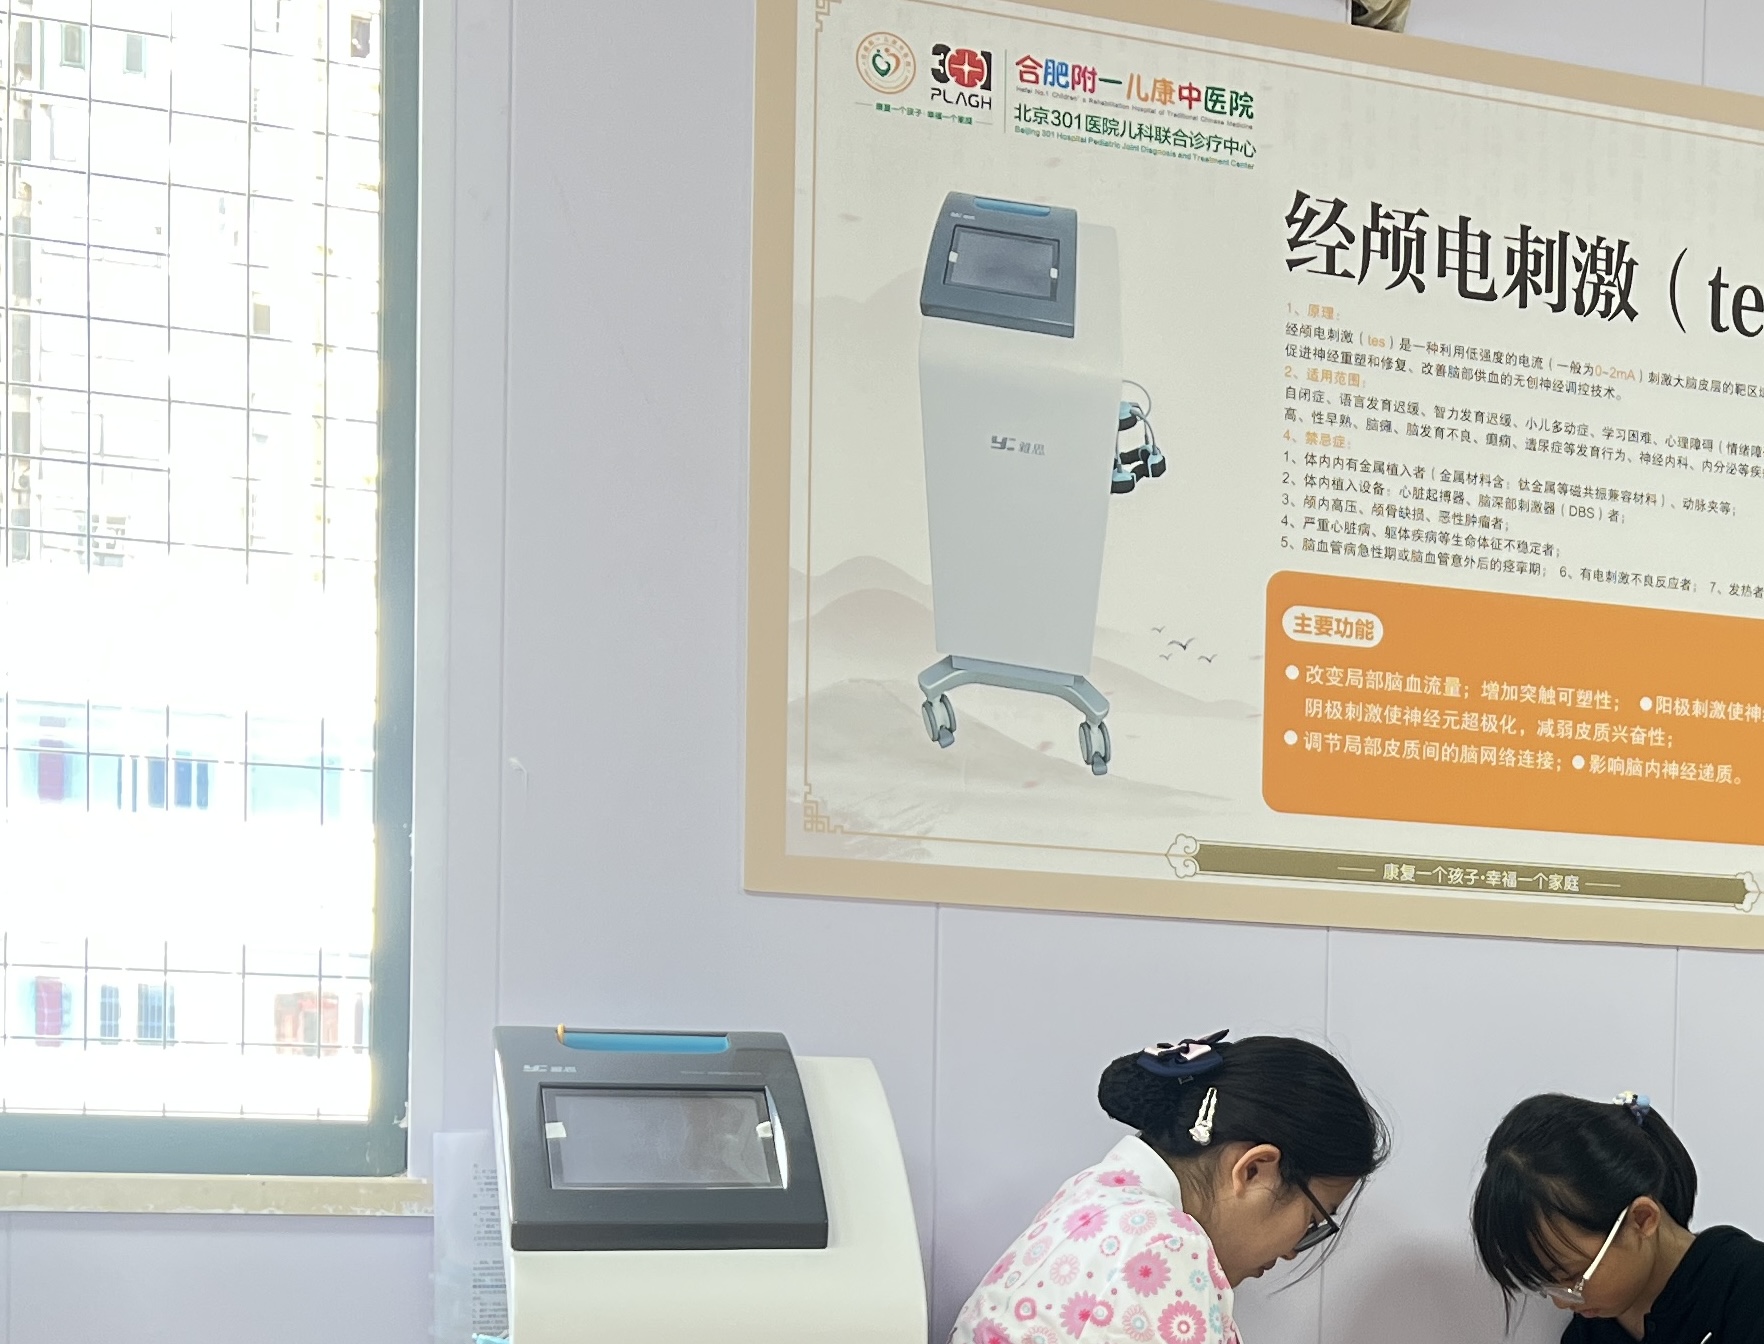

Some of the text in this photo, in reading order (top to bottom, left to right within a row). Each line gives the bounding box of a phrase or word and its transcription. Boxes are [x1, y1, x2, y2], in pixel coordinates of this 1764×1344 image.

[931, 43, 992, 92] 301
[1015, 54, 1254, 119] 合肥附一儿康中医院
[930, 87, 992, 111] PLAGH
[1014, 102, 1257, 159] 北京301医院儿科联合诊疗中心
[1041, 130, 1055, 138] 301
[1056, 131, 1087, 144] Hospital
[1088, 136, 1121, 149] Pediatric
[1140, 145, 1176, 158] Diagnosis
[1177, 151, 1192, 161] and
[1193, 153, 1230, 166] Treatment
[1230, 159, 1255, 170] Center
[1292, 612, 1375, 641] 主要功能
[1304, 663, 1622, 712] 改变局部脑血流量；增加突触可塑性；
[1304, 697, 1674, 750] 阴极刺激使神经元超极化，减弱皮质兴奋性；
[1303, 730, 1743, 786] 调节局部皮质间的脑网络连接； 影响脑内神经递质。
[1382, 860, 1580, 893] 康复一个孩子·幸福一个家庭
